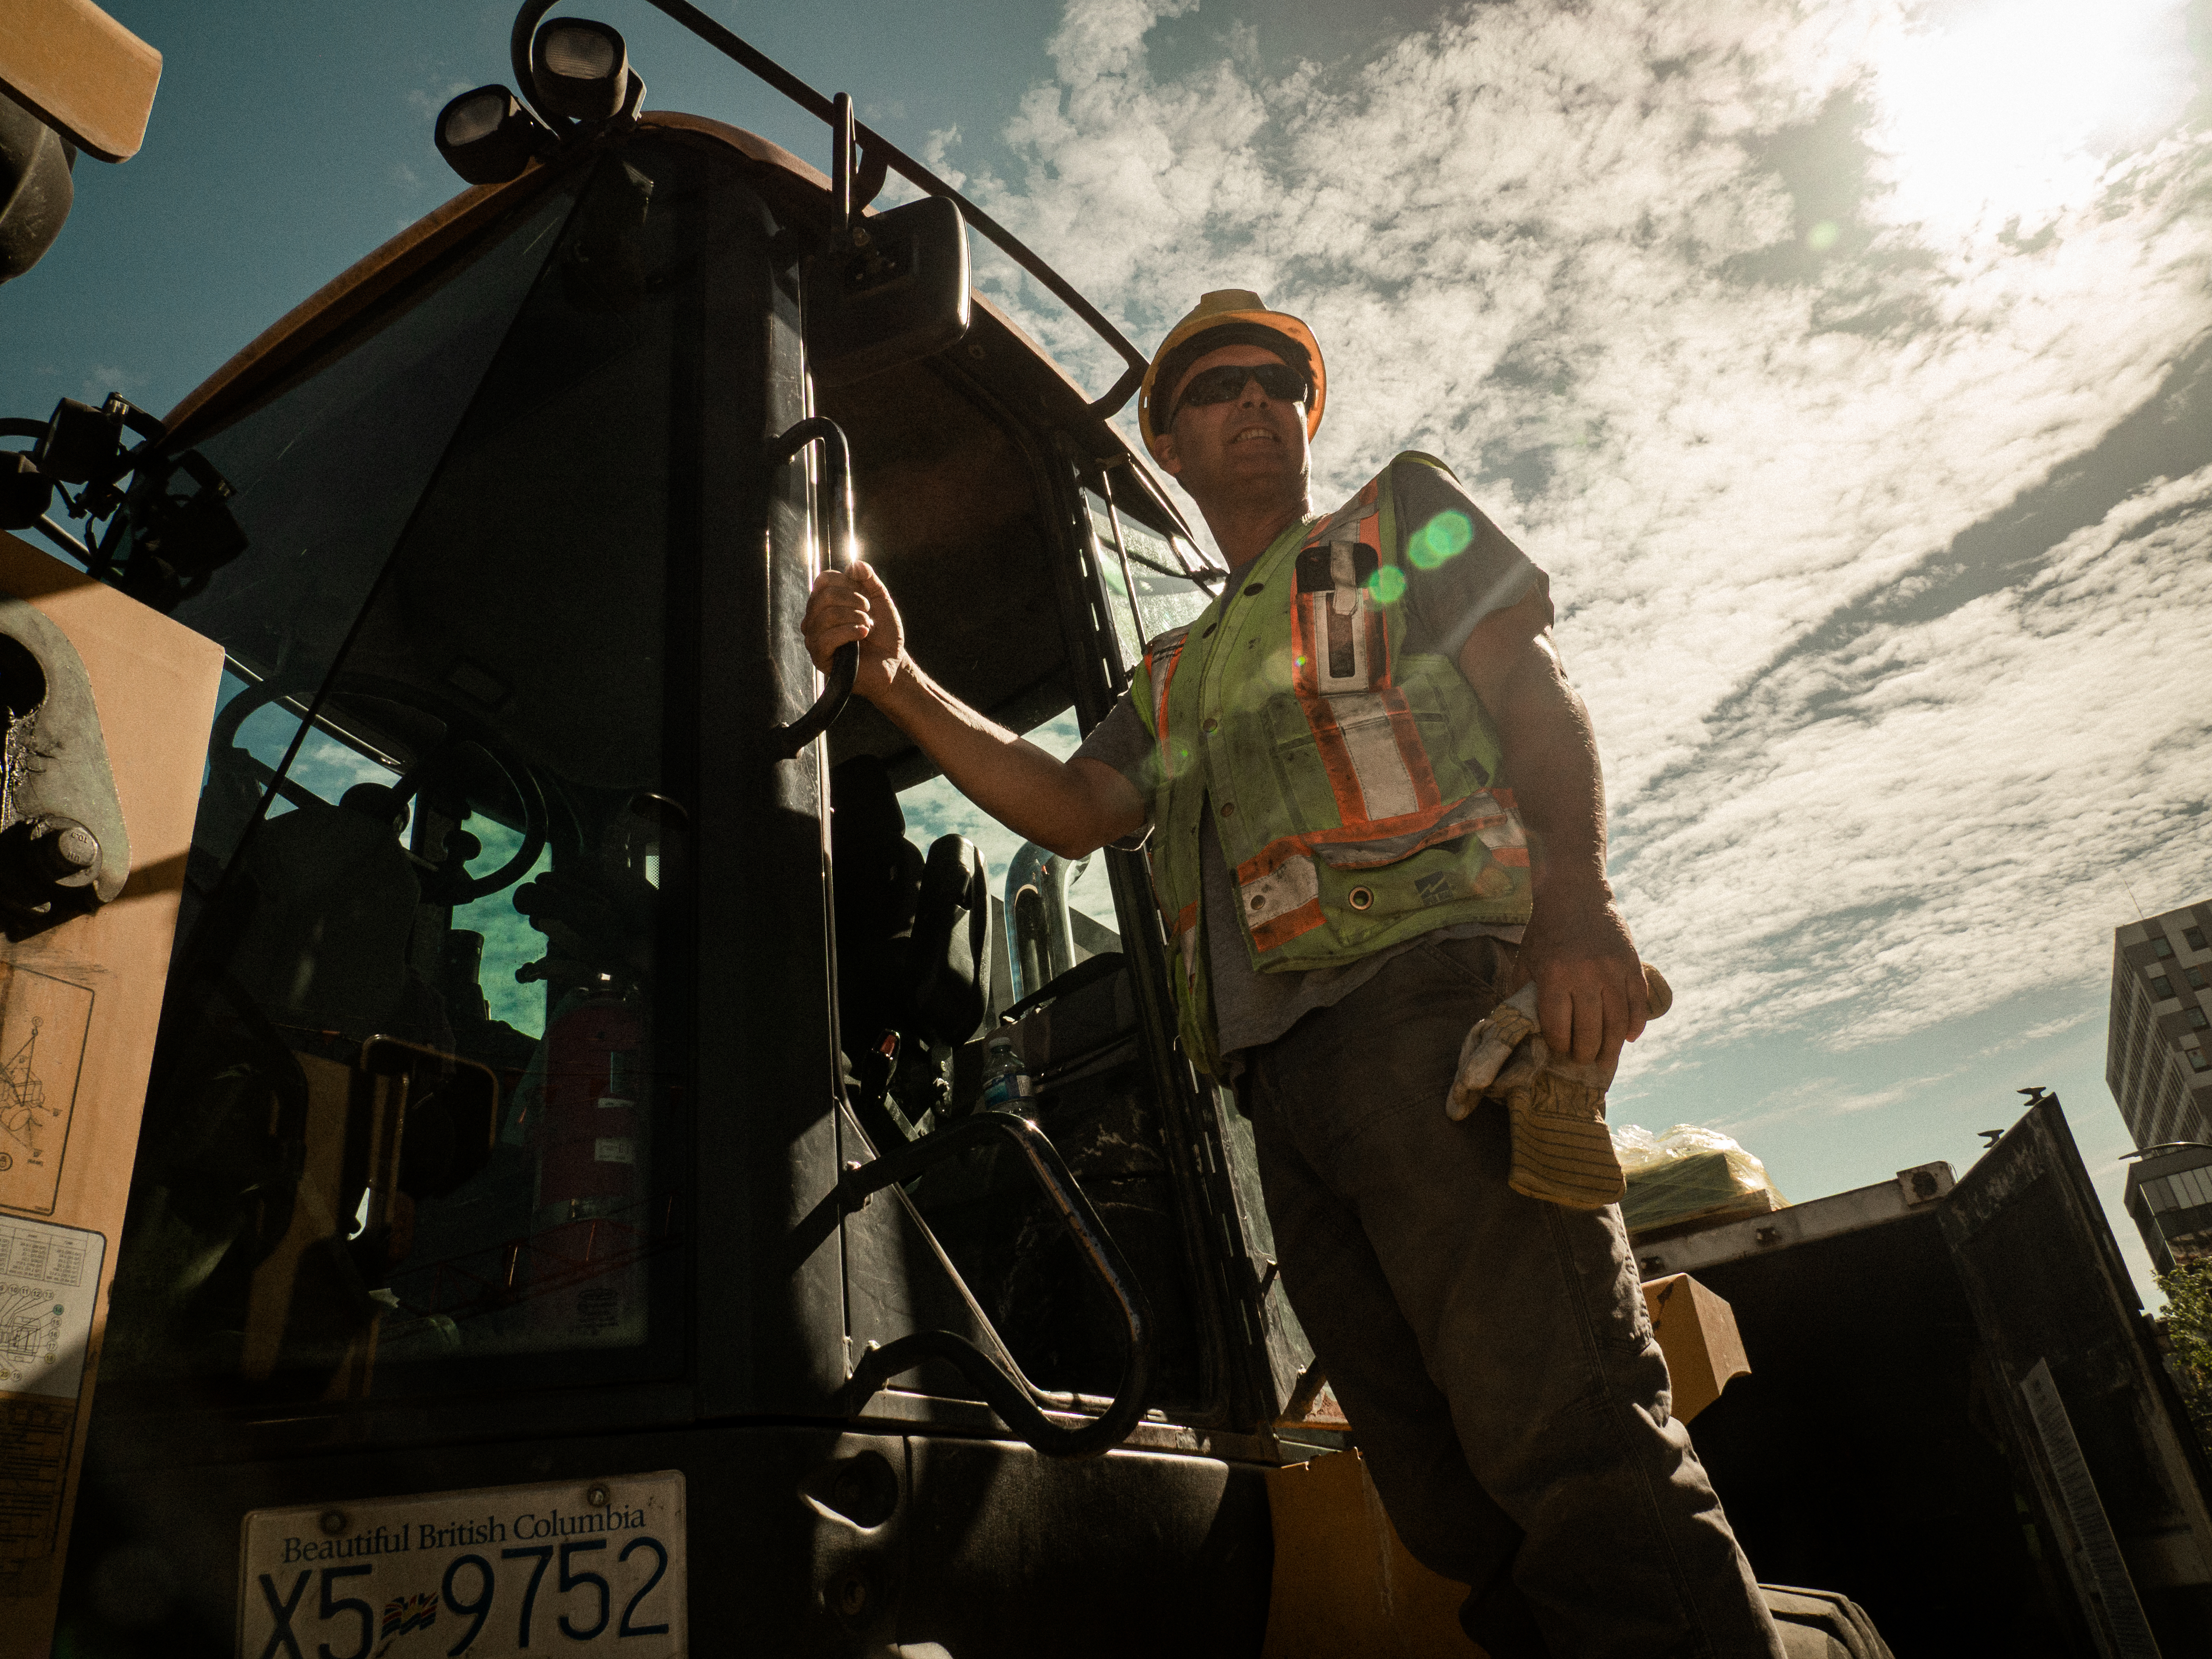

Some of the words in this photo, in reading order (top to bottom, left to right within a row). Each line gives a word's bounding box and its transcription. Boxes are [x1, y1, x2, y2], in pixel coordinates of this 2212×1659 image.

[283, 1523, 409, 1564] Beautiful
[419, 1515, 506, 1550] British
[514, 1504, 646, 1540] Columbia
[259, 1564, 373, 1659] X5
[443, 1537, 669, 1657] 9752
